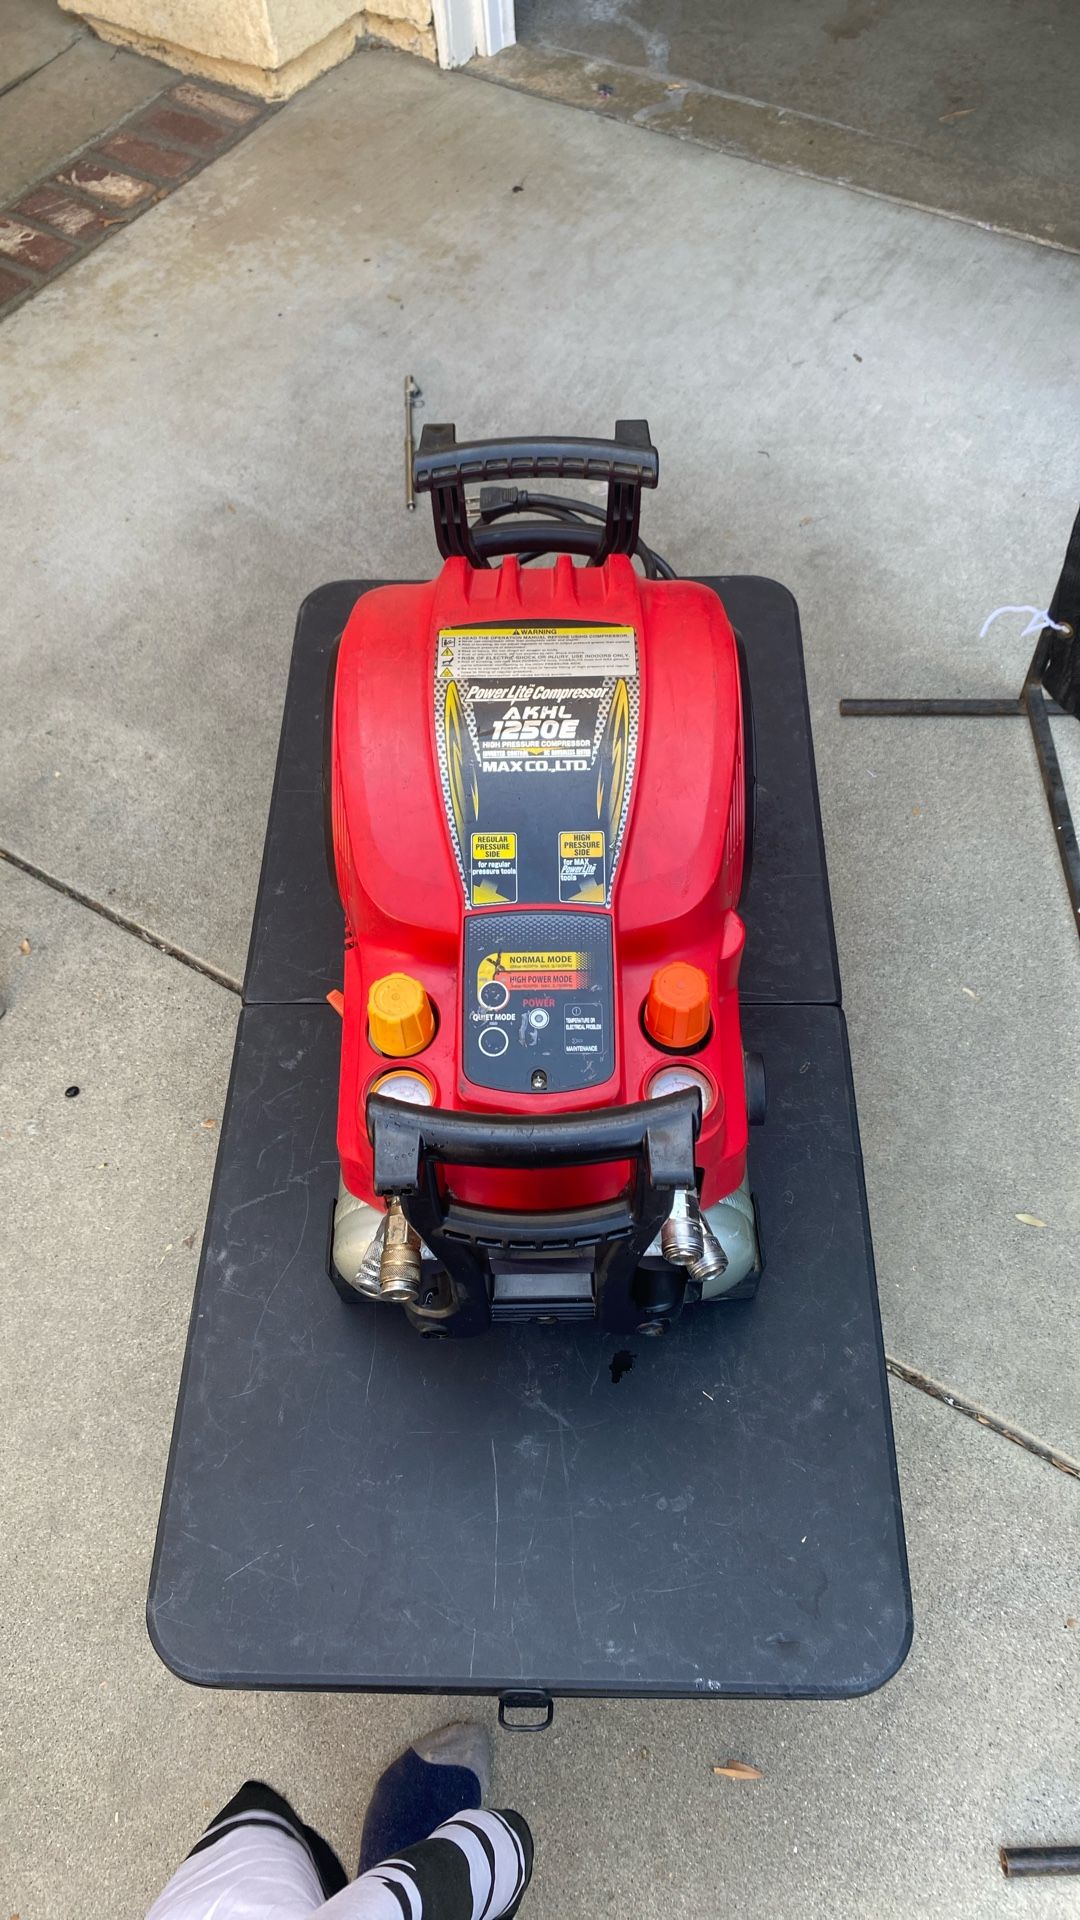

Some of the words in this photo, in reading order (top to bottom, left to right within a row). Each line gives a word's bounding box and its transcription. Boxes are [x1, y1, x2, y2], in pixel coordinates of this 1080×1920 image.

[533, 686, 609, 703] Compressor
[502, 705, 572, 719] AKHL
[492, 719, 579, 739] 1250E
[482, 741, 499, 749] HIGH
[501, 740, 540, 748] PRESSURE
[540, 739, 591, 747] COMPRESSOR
[482, 760, 523, 773] MAX
[477, 835, 508, 843] REGULAR
[564, 841, 600, 849] PRESSURE
[484, 850, 501, 858] SIDE
[500, 867, 517, 875] tools
[510, 975, 526, 983] HIGH
[527, 975, 552, 983] POWER
[553, 975, 572, 983] MODE
[522, 998, 556, 1008] POWER
[472, 1013, 494, 1022] QUIET
[494, 1013, 516, 1021] MODE
